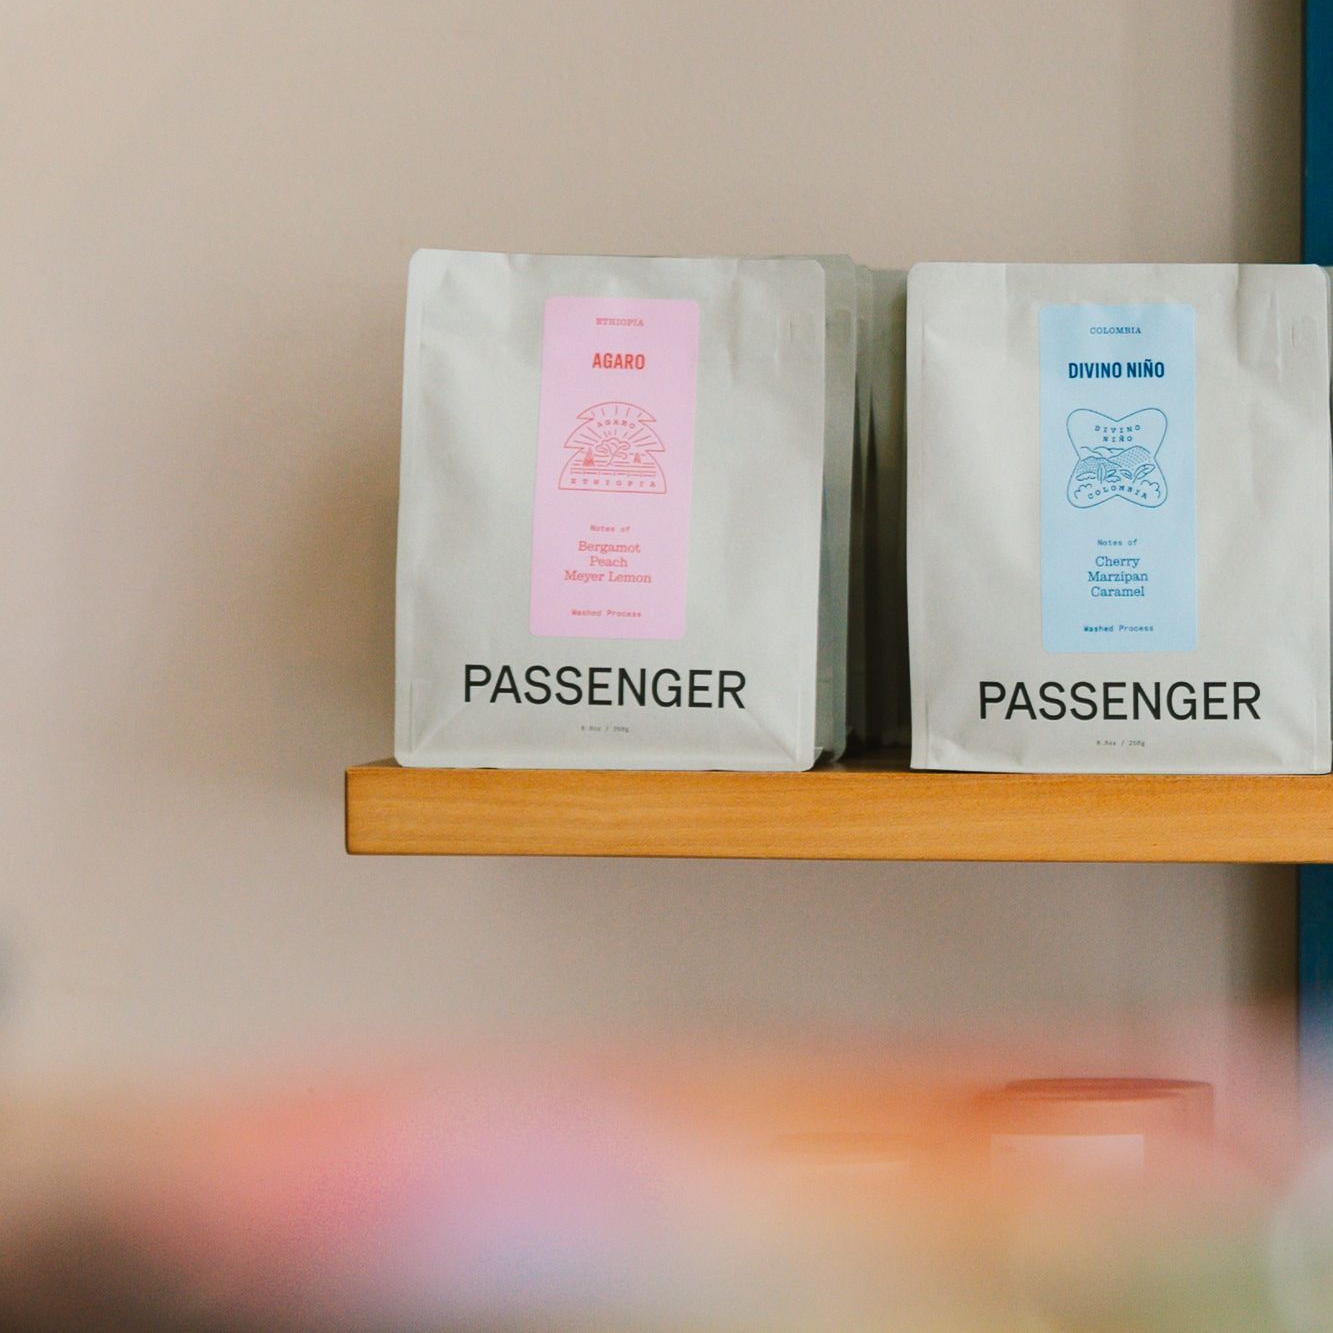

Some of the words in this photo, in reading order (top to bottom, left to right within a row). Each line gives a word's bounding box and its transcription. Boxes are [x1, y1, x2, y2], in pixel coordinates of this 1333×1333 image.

[1090, 326, 1142, 335] COLOMBIA
[592, 352, 646, 371] AGARO
[1068, 361, 1123, 379] DIVINO
[1126, 358, 1165, 379] NIÑO
[577, 539, 641, 555] Bergamot
[589, 555, 629, 568] Peach
[1094, 555, 1141, 570] Cherry
[563, 569, 606, 584] Meyer
[607, 570, 652, 584] Lemon
[1087, 570, 1149, 585] Marzipan
[1090, 585, 1145, 598] Caramel
[1083, 625, 1114, 633] Washed
[1118, 624, 1154, 632] Process
[464, 663, 746, 709] PASSENGER
[979, 680, 1261, 721] PASSENGER
